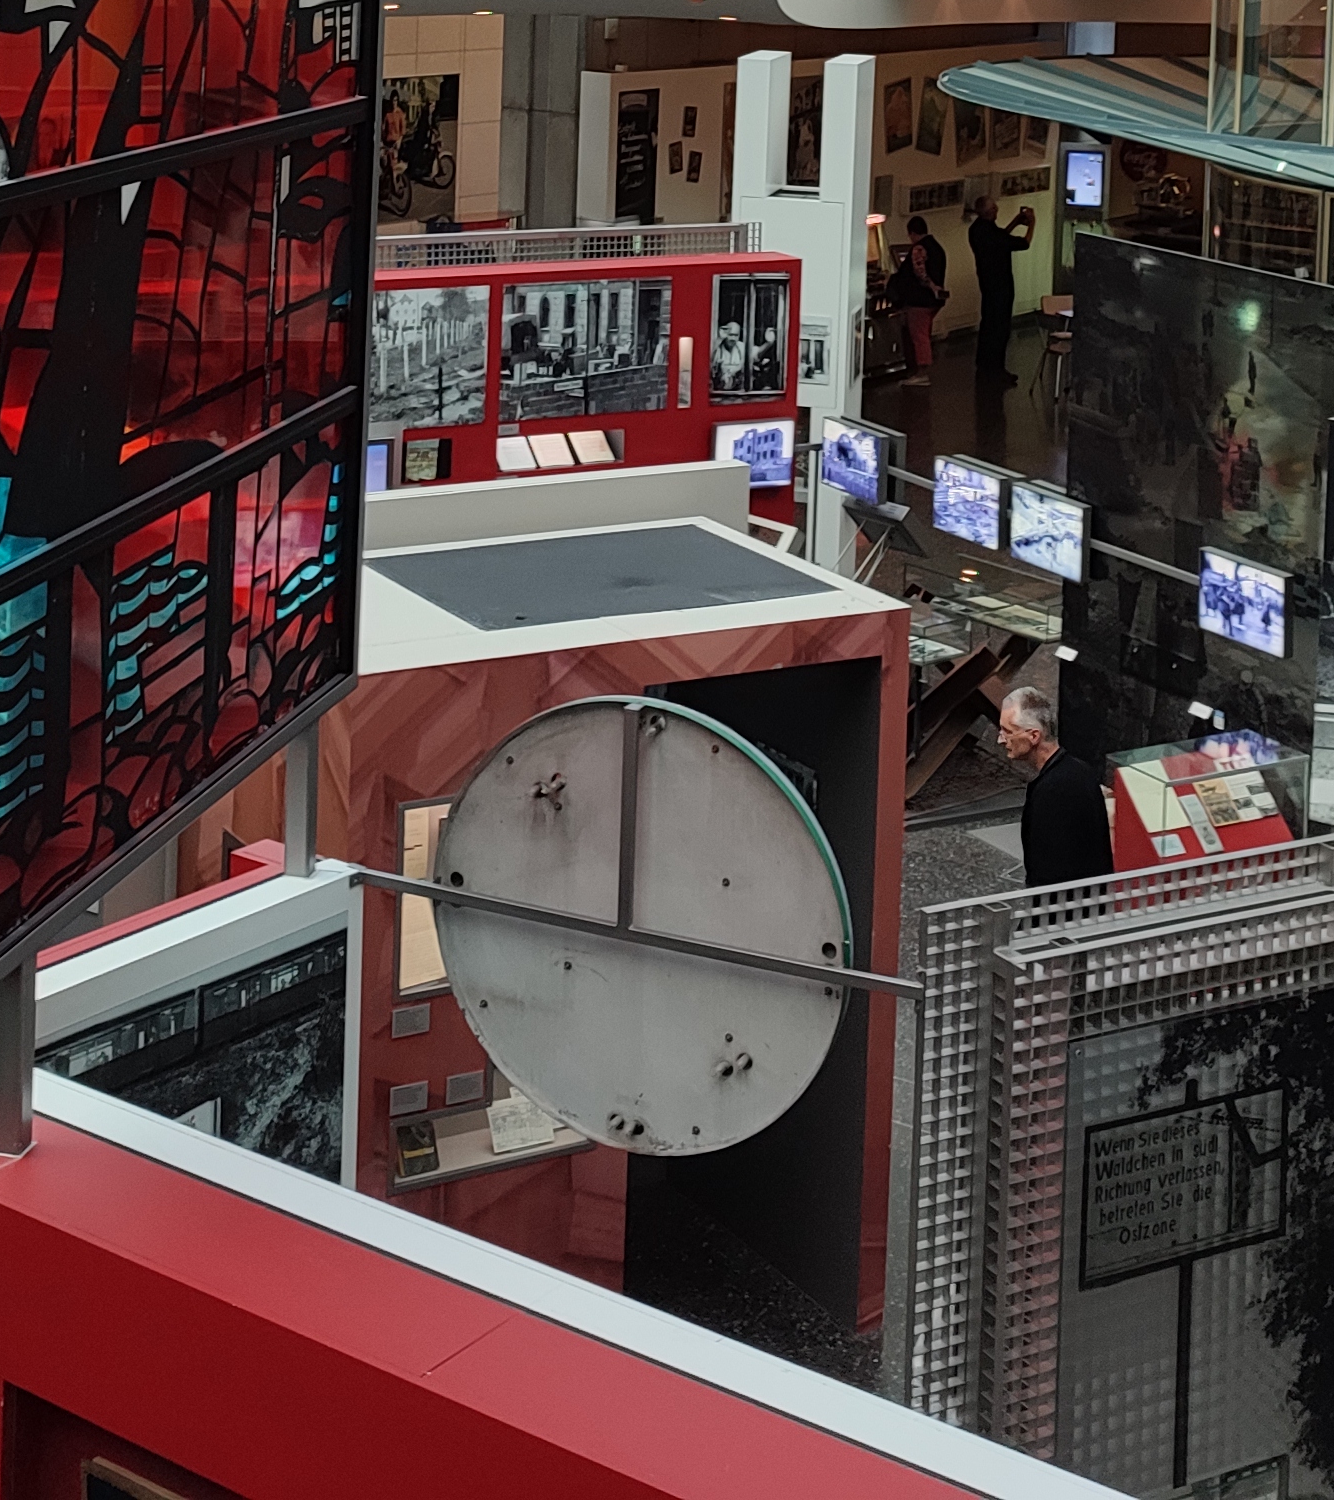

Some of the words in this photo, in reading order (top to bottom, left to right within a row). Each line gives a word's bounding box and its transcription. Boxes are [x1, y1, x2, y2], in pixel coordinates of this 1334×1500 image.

[1094, 1137, 1135, 1158] Wenn
[1138, 1132, 1160, 1149] Sie
[1161, 1120, 1200, 1143] dieses
[1171, 1146, 1184, 1163] in
[1095, 1177, 1152, 1204] Richtung
[1099, 1200, 1155, 1227] betreten
[1160, 1191, 1184, 1211] Sie
[1192, 1183, 1212, 1203] die
[1118, 1218, 1178, 1245] Ostzone
